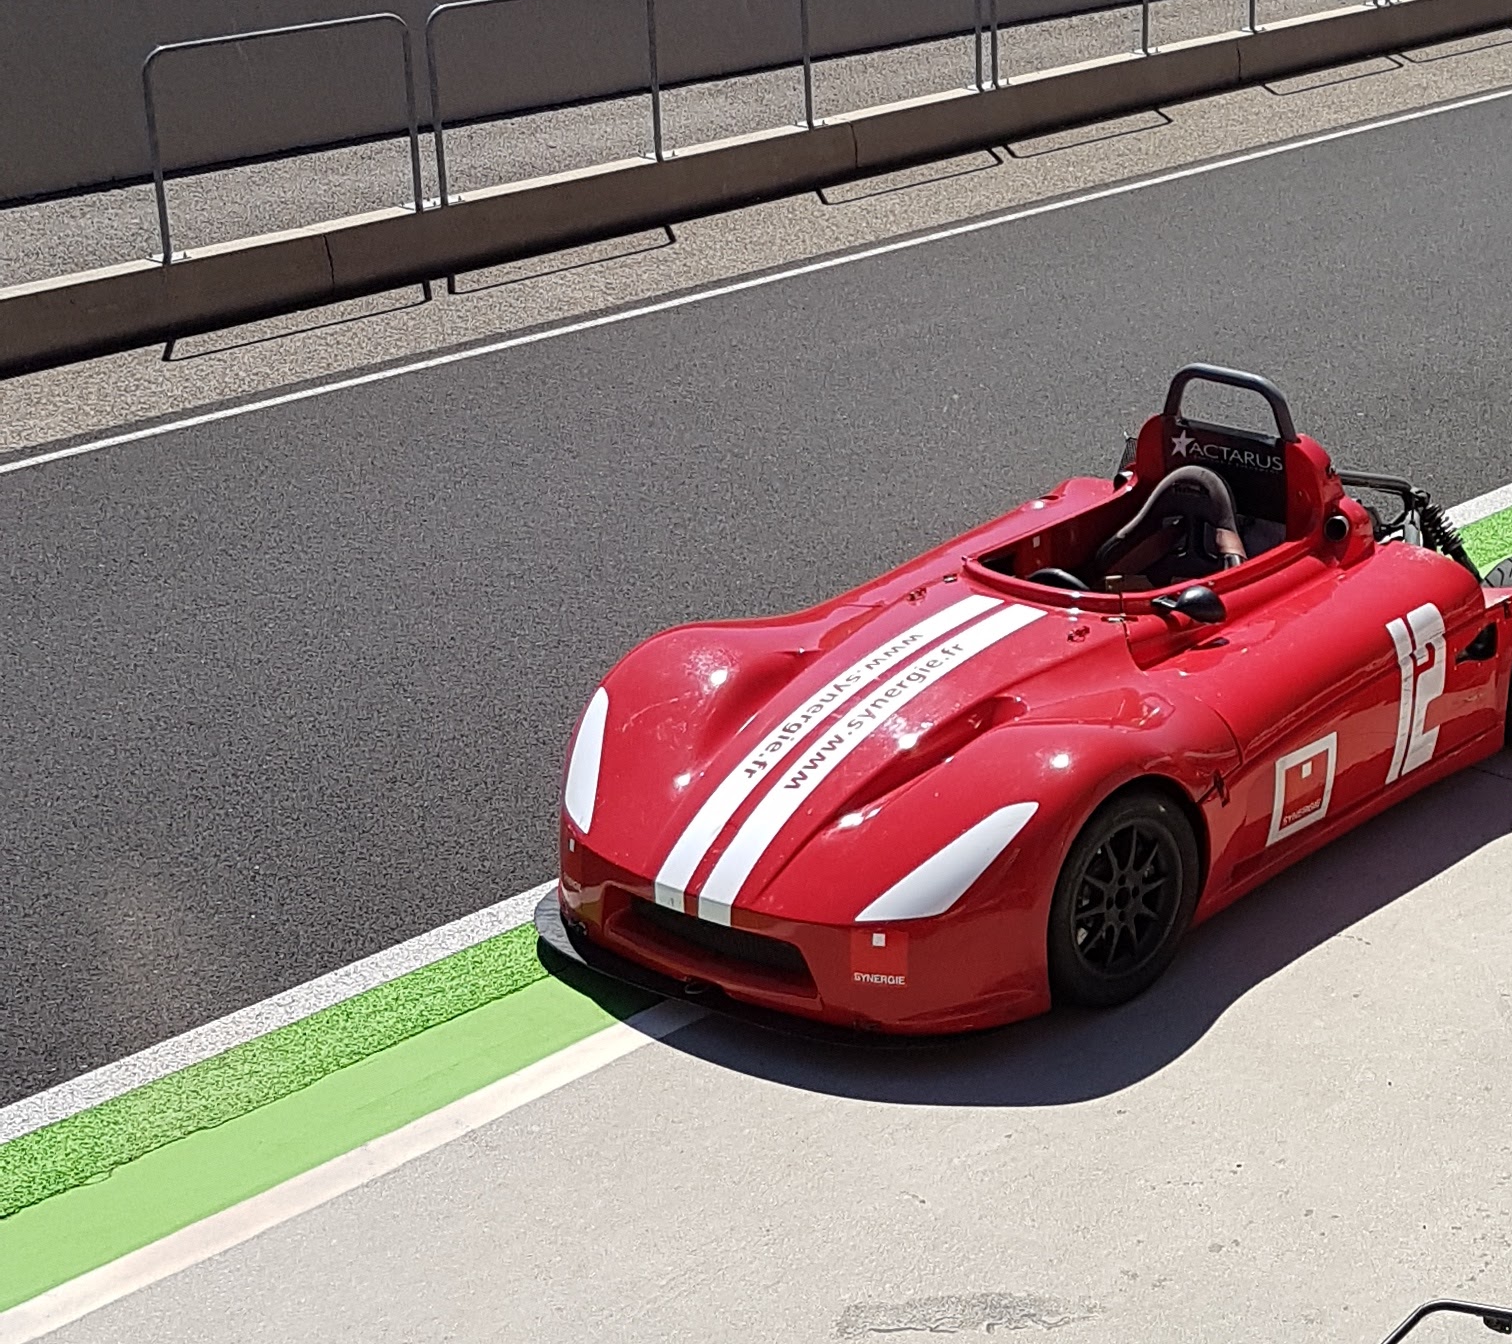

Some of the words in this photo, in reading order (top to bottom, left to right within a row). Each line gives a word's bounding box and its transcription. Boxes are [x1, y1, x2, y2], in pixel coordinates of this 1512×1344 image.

[1189, 442, 1283, 471] ACTARUS
[744, 633, 923, 779] www.synergie.fr
[784, 643, 964, 790] www.synergie.fr
[1385, 602, 1446, 785] 12
